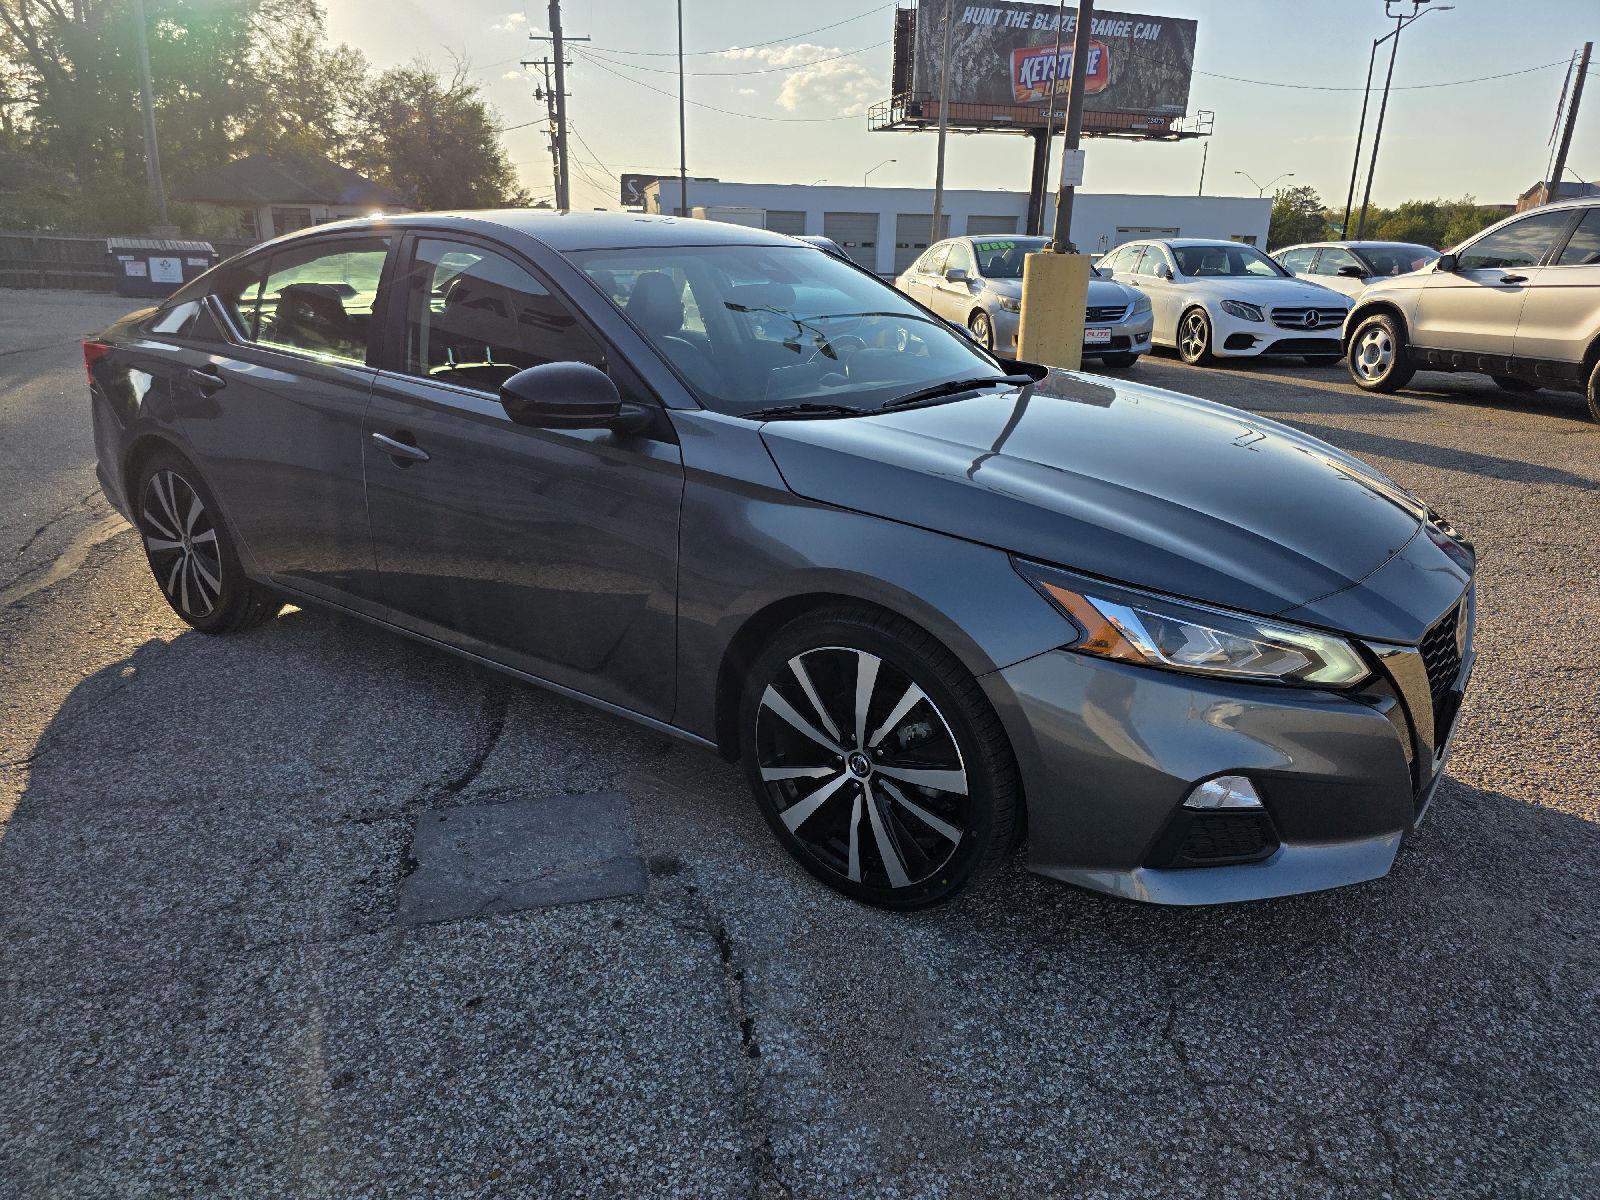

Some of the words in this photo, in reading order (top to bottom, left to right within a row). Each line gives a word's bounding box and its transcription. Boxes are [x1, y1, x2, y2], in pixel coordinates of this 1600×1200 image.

[962, 6, 1003, 26] HUNT
[1005, 9, 1032, 29] THE
[1032, 13, 1077, 33] BLAZE
[1089, 17, 1133, 38] RANGE
[1133, 22, 1162, 41] CAN
